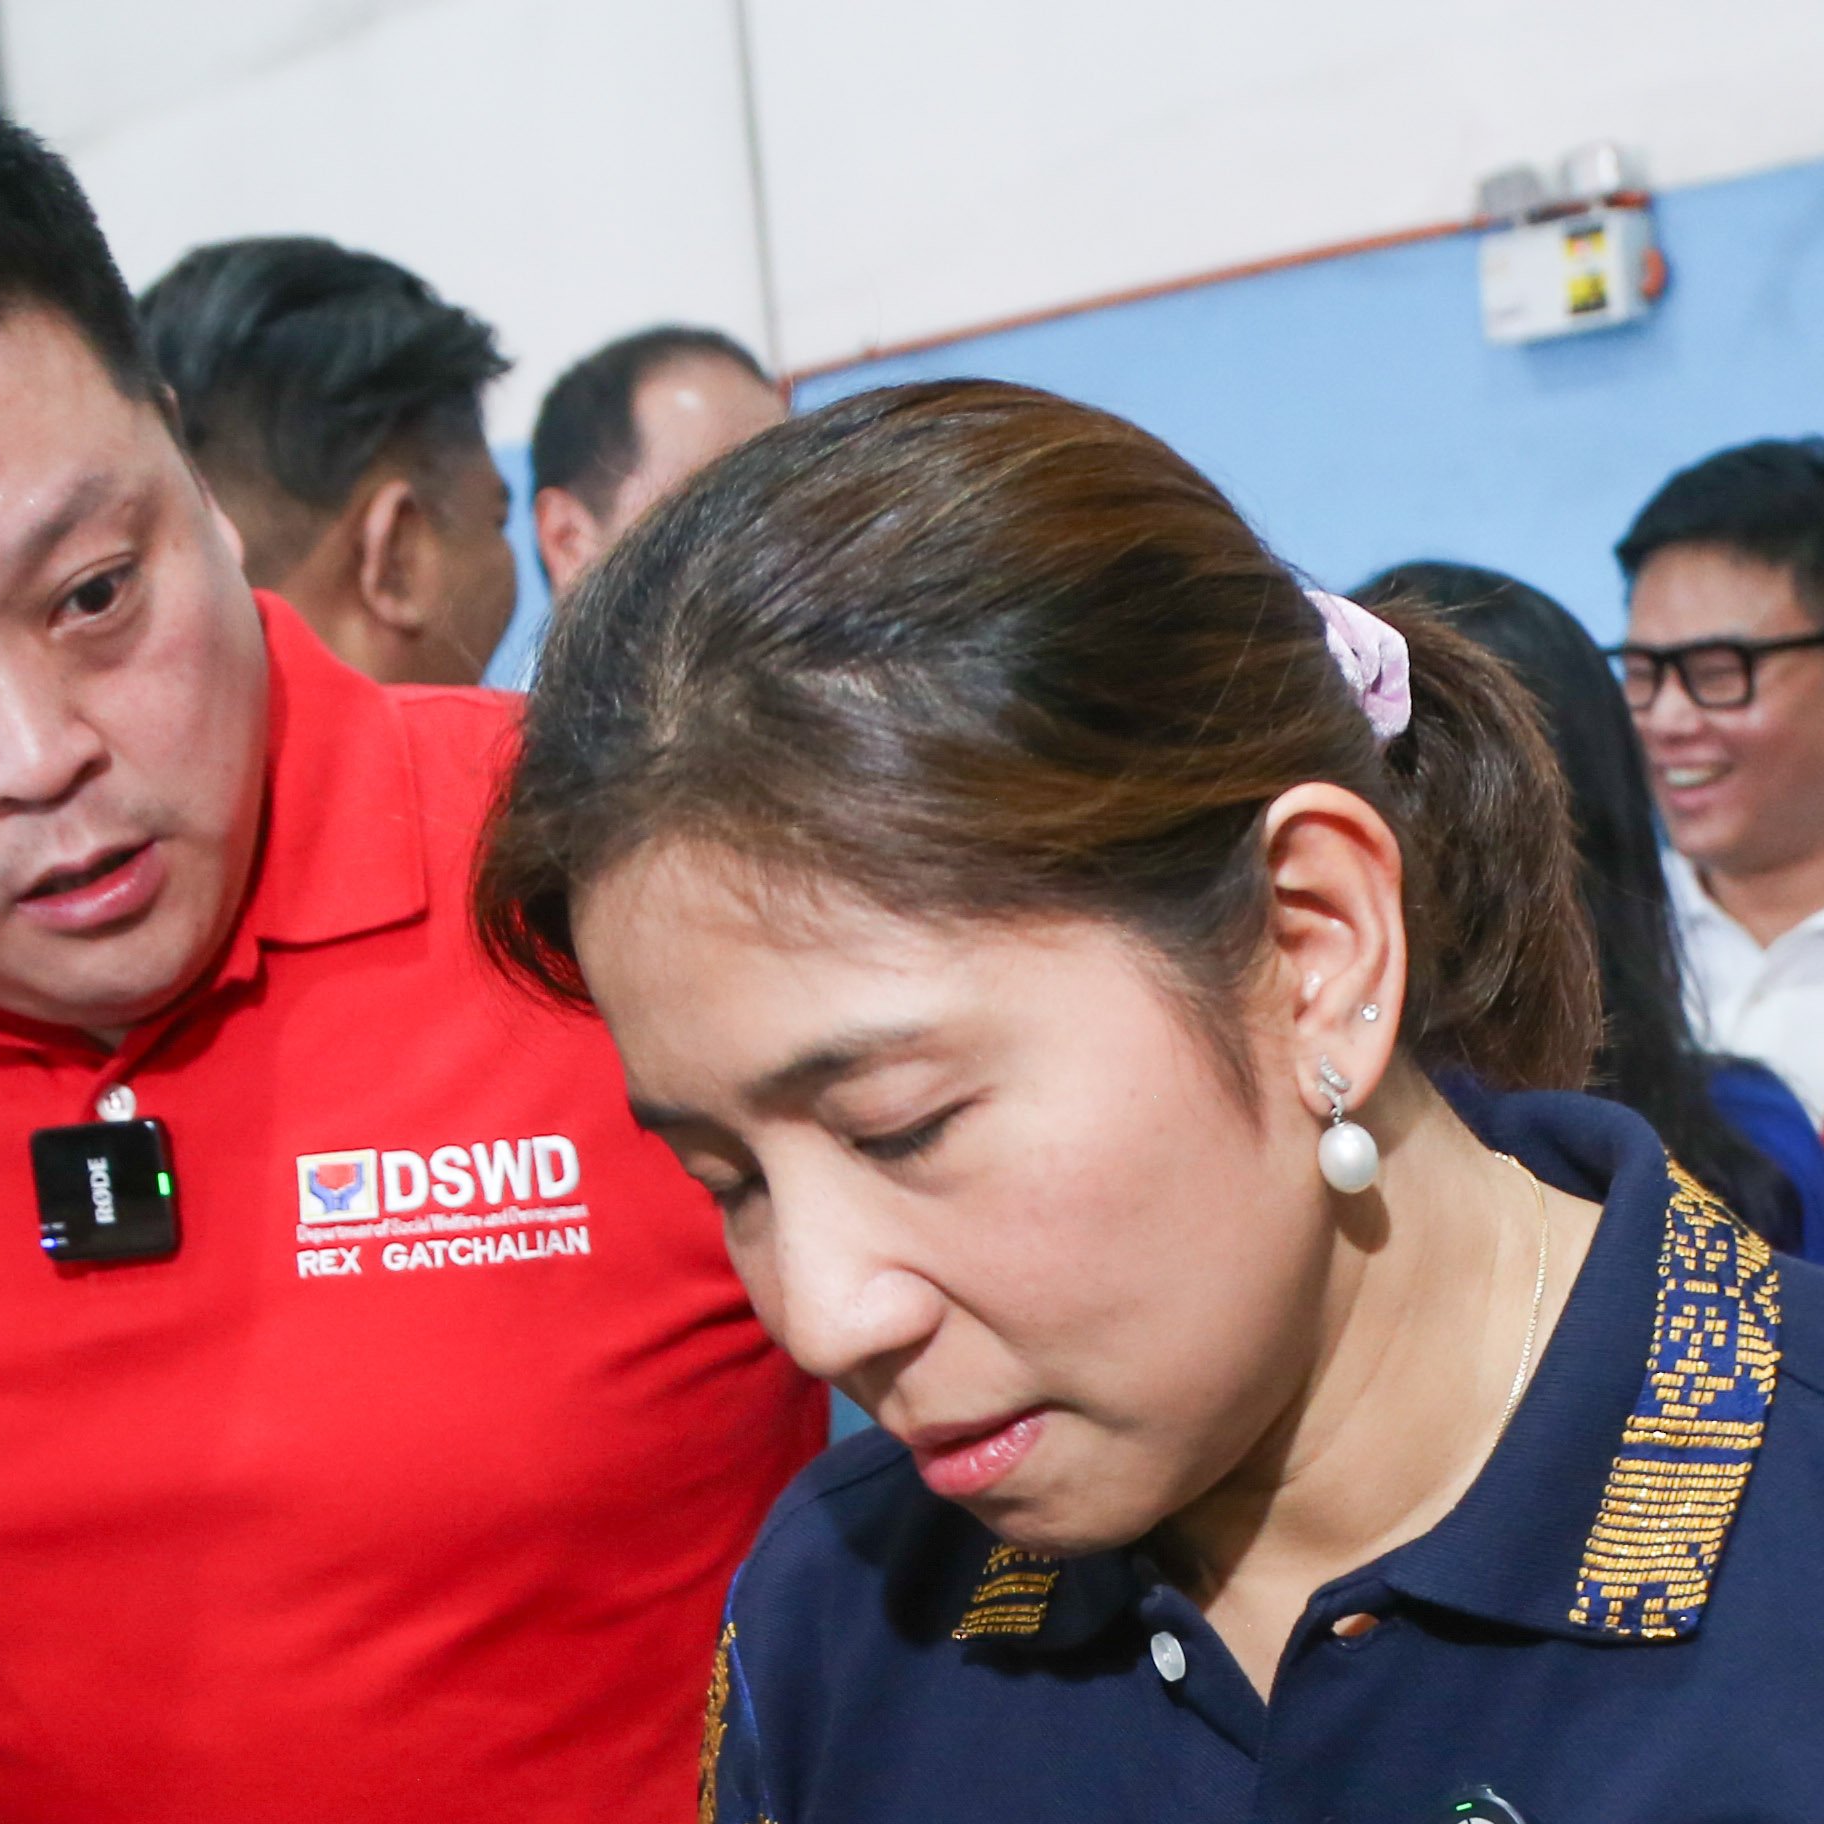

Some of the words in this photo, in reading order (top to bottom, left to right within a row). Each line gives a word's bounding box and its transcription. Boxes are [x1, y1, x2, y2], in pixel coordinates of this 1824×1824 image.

[381, 1134, 580, 1212] DSWD
[296, 1246, 363, 1279] REX
[382, 1226, 591, 1272] GATCHALIAN
